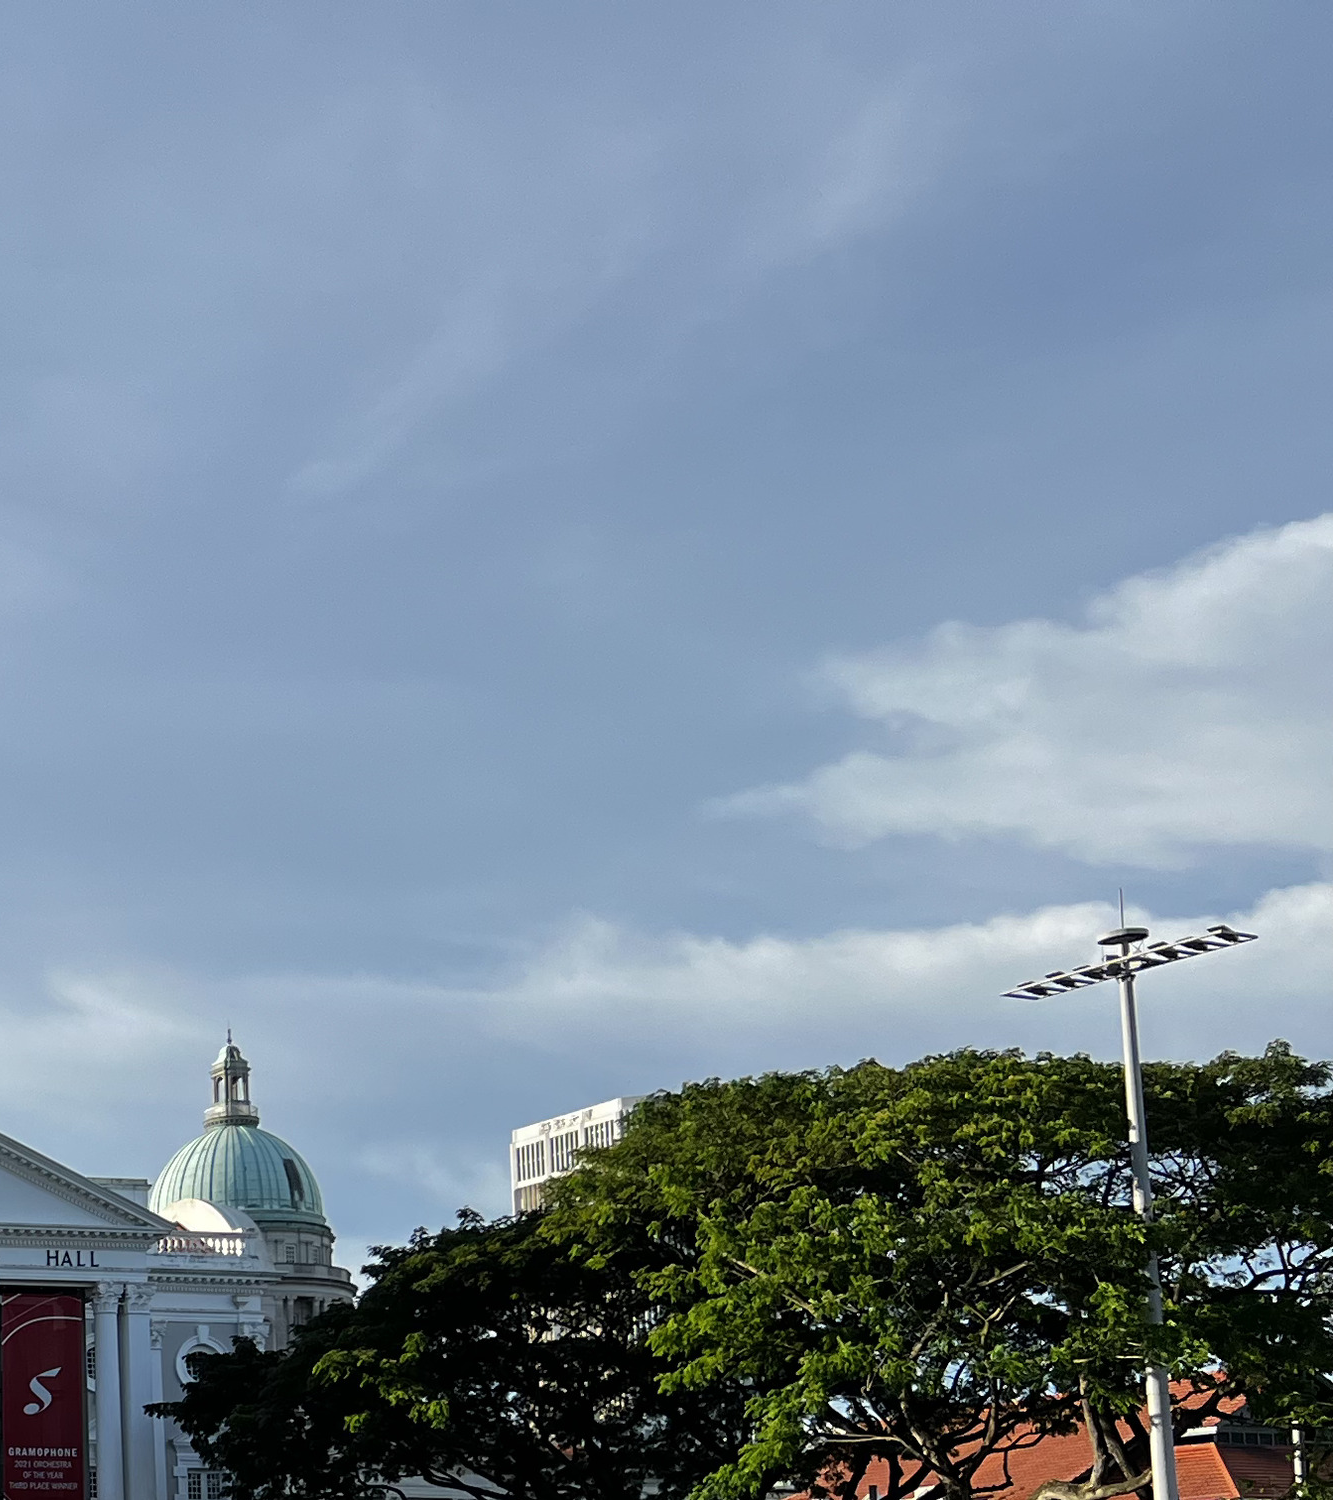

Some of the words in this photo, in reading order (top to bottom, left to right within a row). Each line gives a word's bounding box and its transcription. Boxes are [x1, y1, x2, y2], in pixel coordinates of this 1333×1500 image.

[46, 1249, 100, 1268] HALL
[8, 1447, 78, 1457] GRAMOPHONE
[33, 1460, 72, 1468] ORCHESTRA
[22, 1471, 32, 1479] OF
